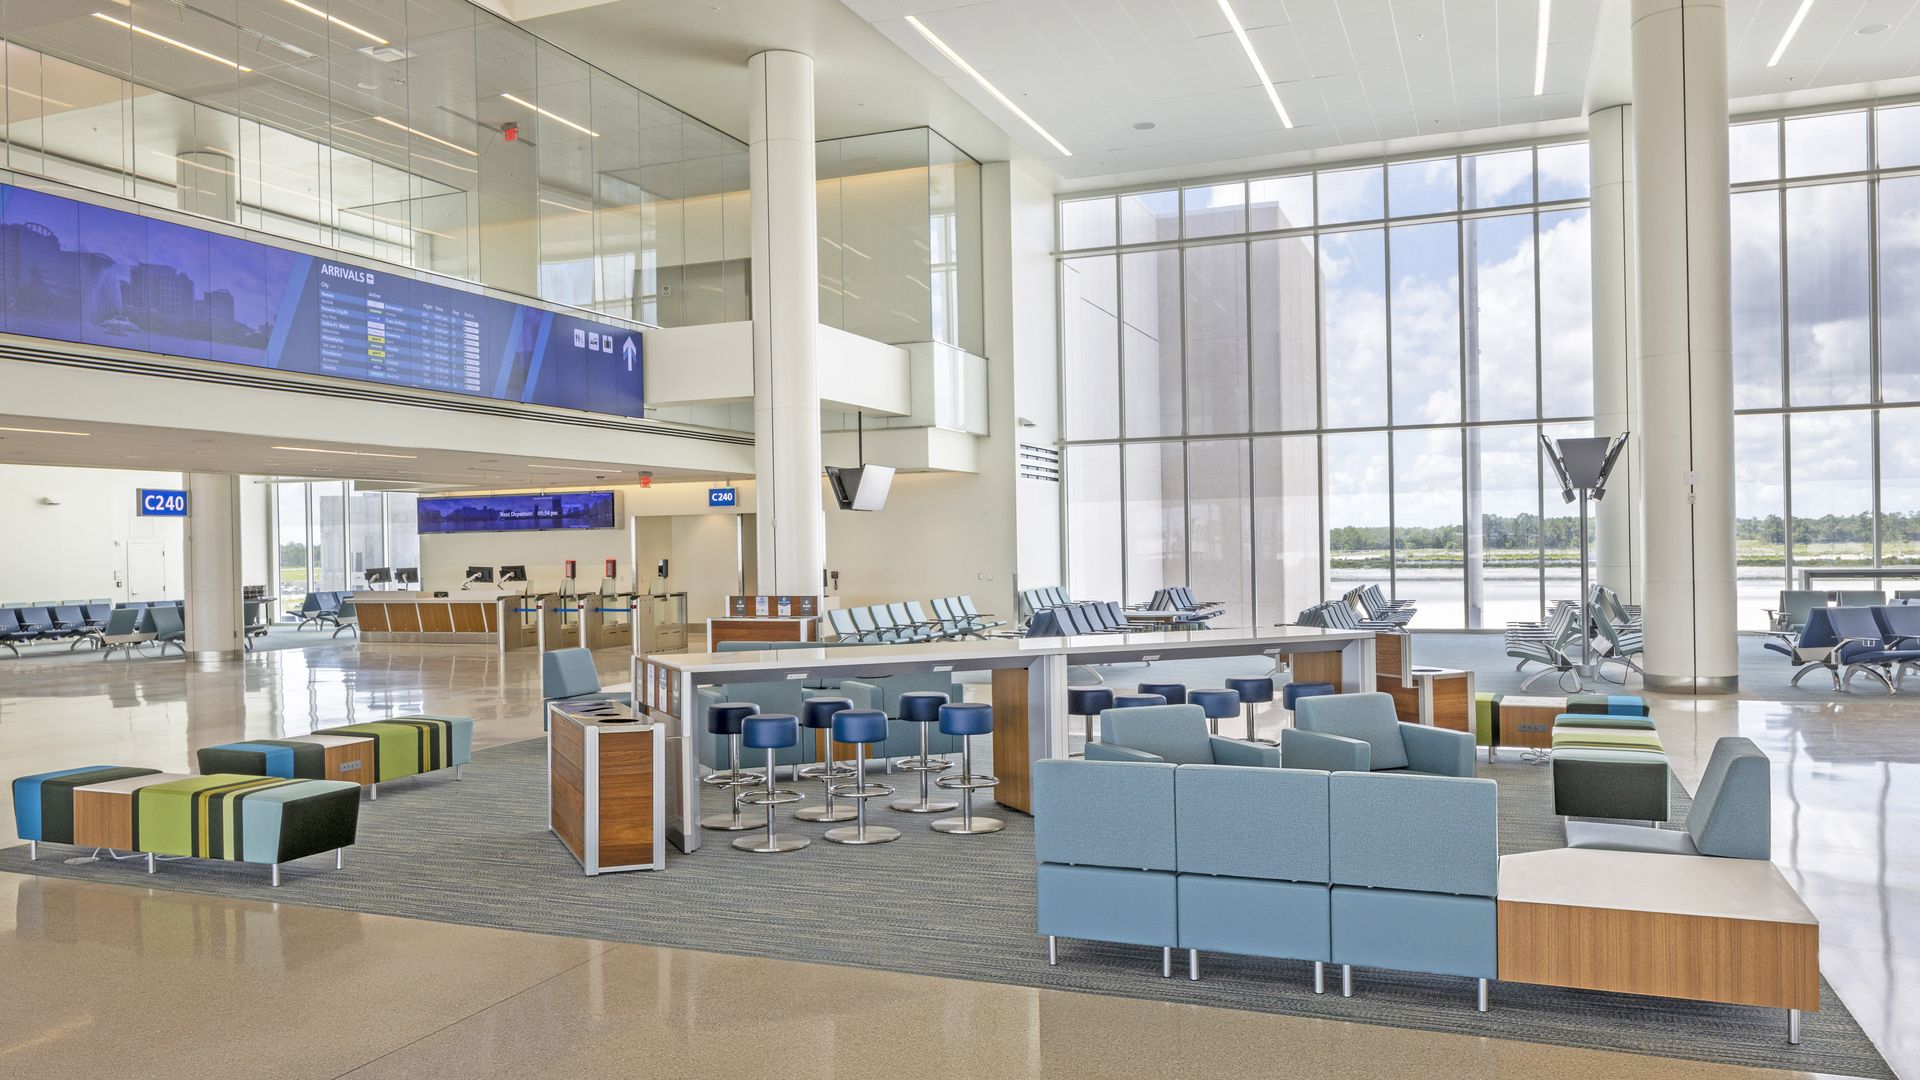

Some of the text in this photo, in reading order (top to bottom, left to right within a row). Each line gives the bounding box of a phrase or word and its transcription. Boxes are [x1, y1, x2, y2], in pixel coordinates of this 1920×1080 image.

[321, 264, 365, 282] ARRIVALS
[145, 495, 184, 511] C240
[712, 493, 733, 501] C240
